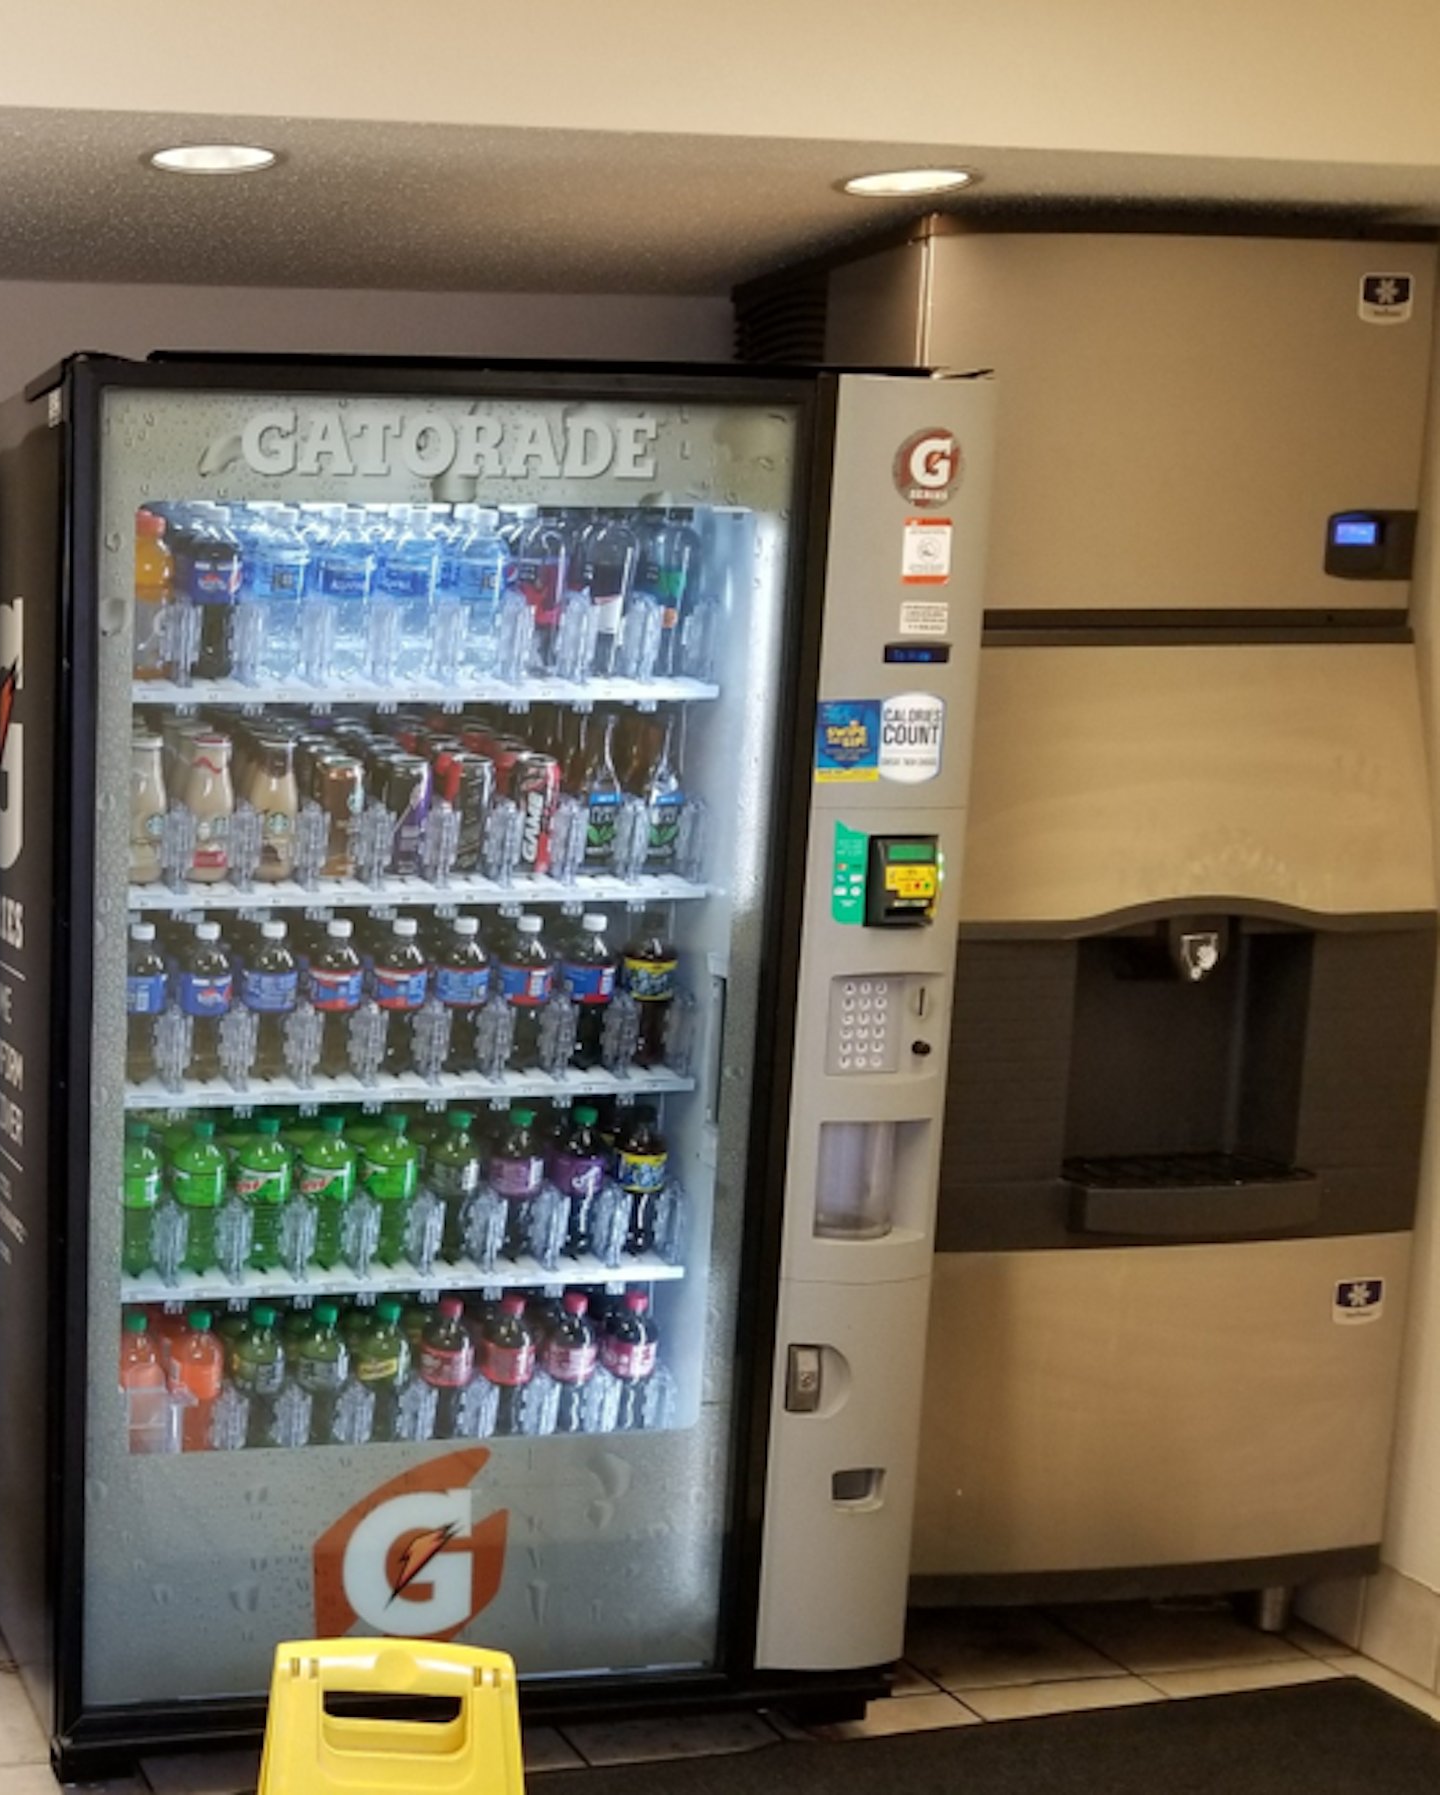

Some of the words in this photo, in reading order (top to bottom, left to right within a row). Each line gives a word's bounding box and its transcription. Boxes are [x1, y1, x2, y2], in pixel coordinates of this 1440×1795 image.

[242, 411, 658, 479] GATORADE
[883, 725, 939, 744] COUNT
[343, 1488, 473, 1635] G
